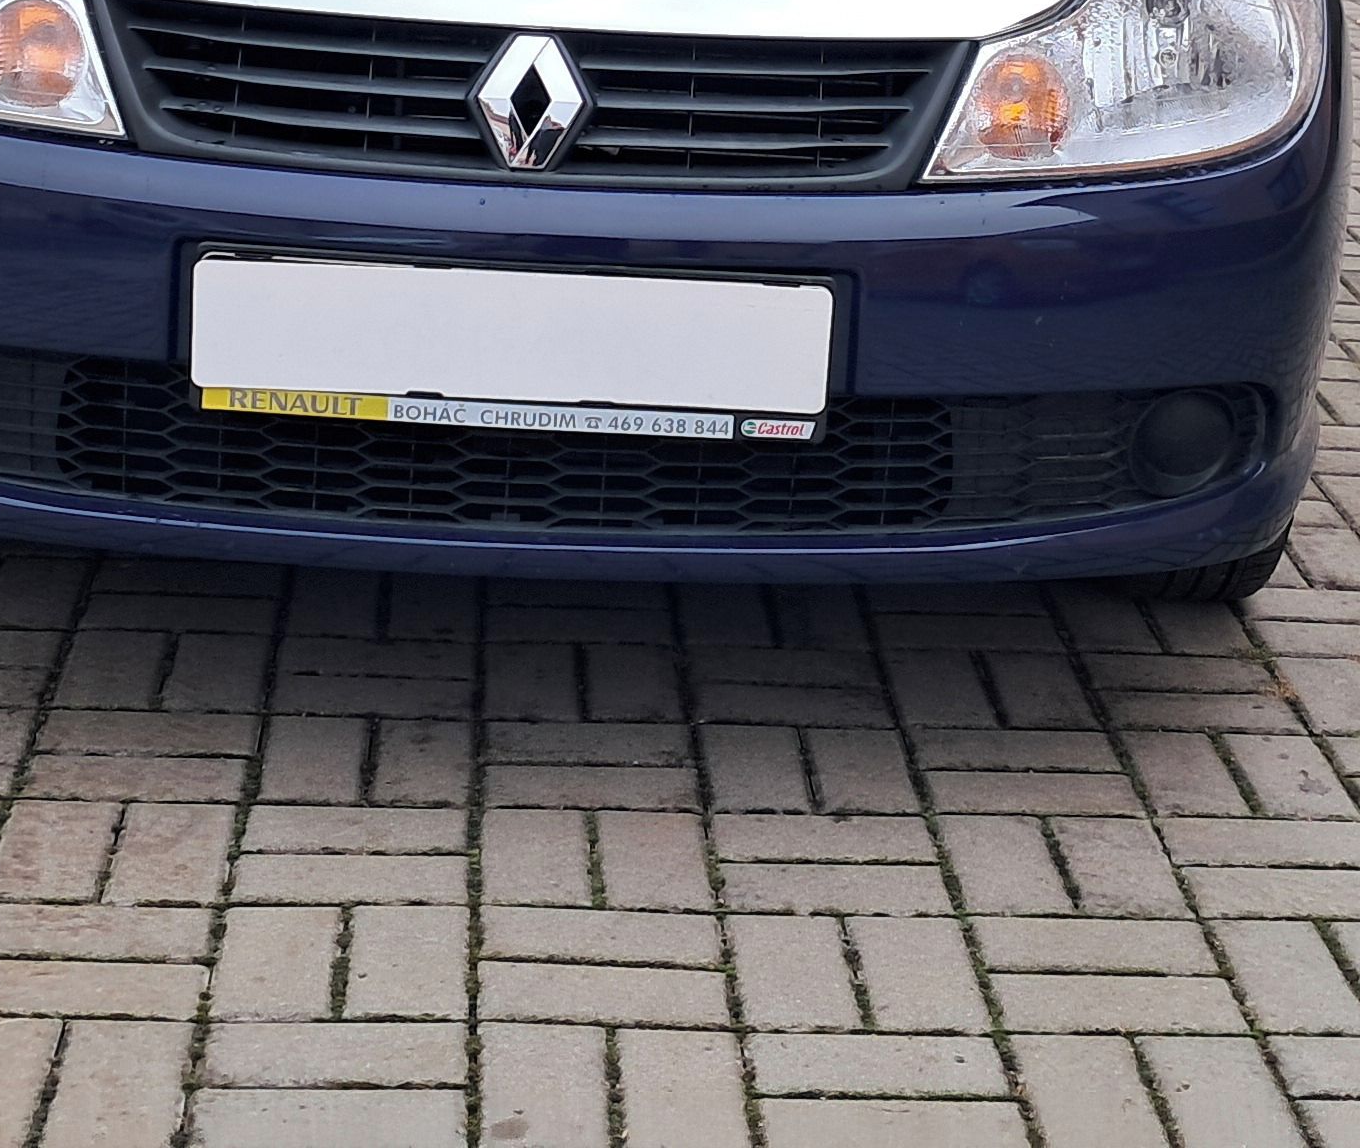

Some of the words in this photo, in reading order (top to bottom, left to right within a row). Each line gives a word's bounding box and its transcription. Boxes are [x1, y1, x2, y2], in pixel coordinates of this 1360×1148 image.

[228, 389, 363, 416] RENAULT
[393, 403, 466, 423] BOHÁČ
[480, 409, 576, 429] CHRUDIM
[607, 416, 644, 432] 469
[651, 417, 687, 434] 638
[694, 419, 730, 436] 844
[758, 422, 805, 437] Castrol
